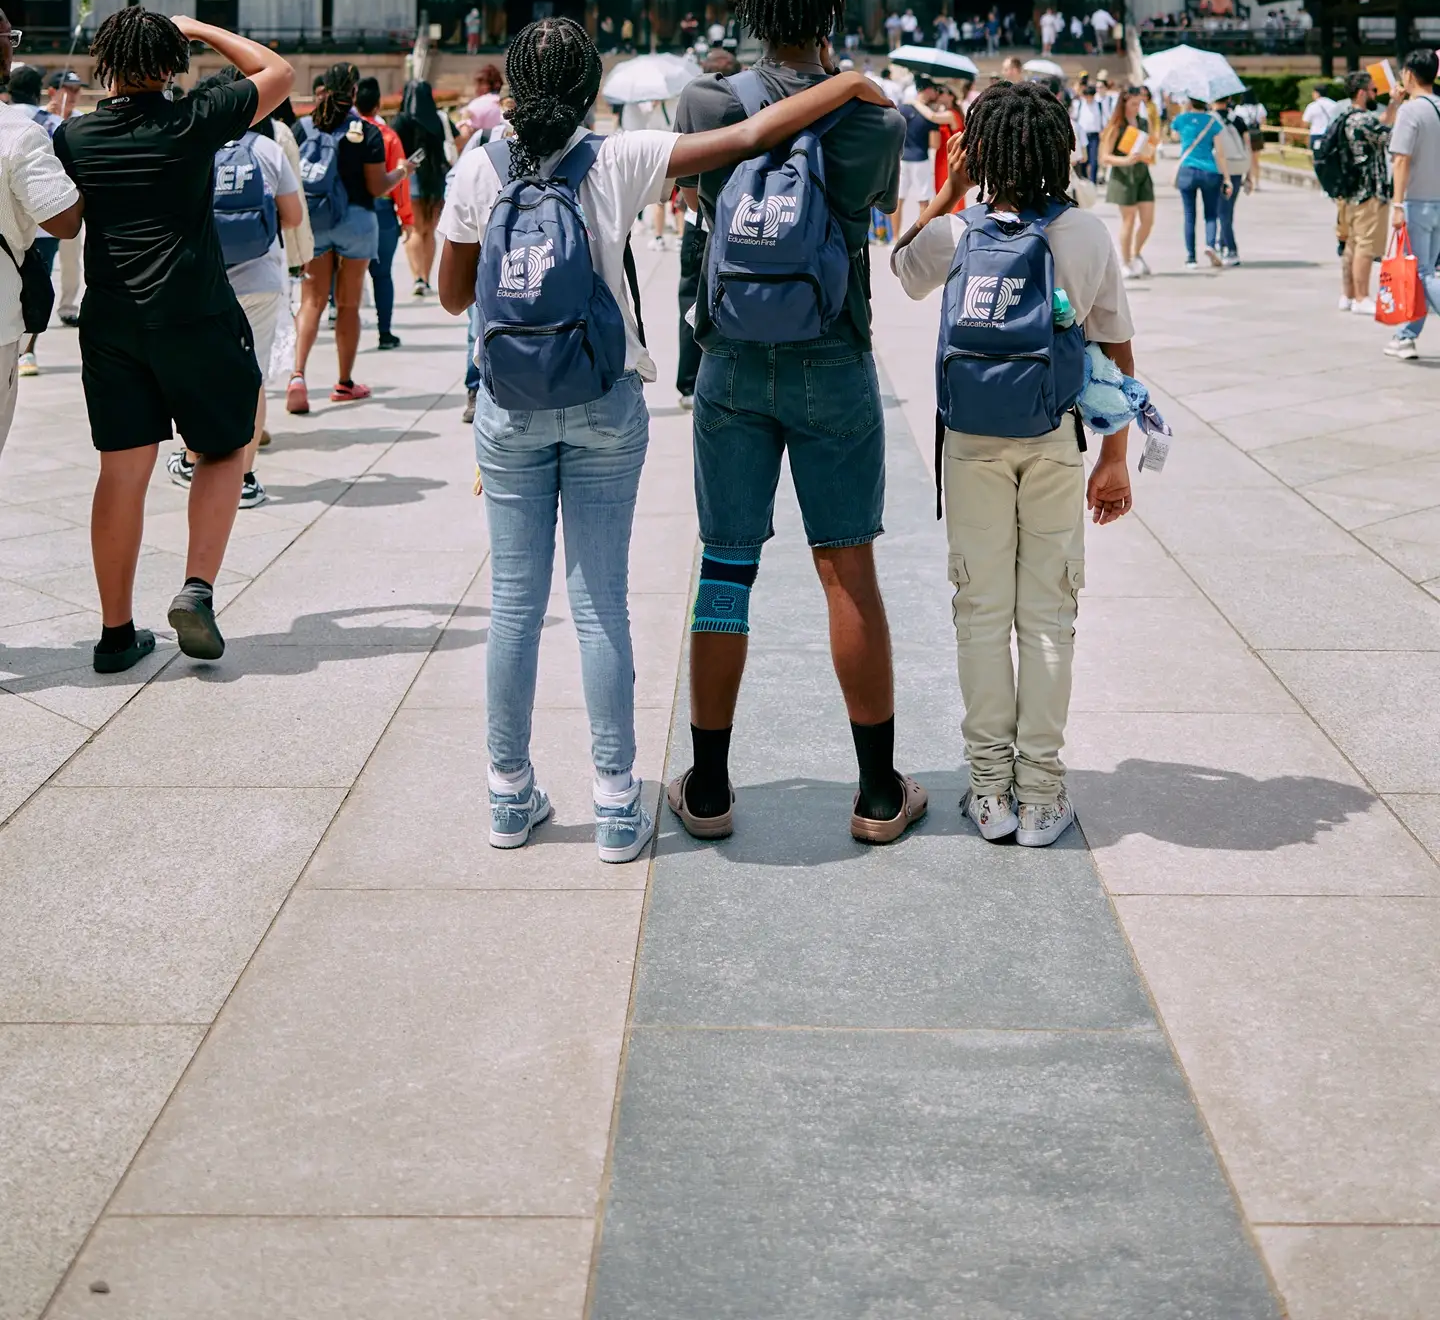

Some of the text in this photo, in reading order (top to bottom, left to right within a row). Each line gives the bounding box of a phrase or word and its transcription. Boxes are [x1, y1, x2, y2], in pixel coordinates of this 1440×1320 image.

[215, 164, 254, 190] EF
[729, 193, 796, 237] EF
[728, 235, 760, 245] Education
[499, 238, 555, 290] EF
[497, 289, 541, 298] Education First
[961, 276, 1026, 319] EF
[957, 319, 992, 328] Education
